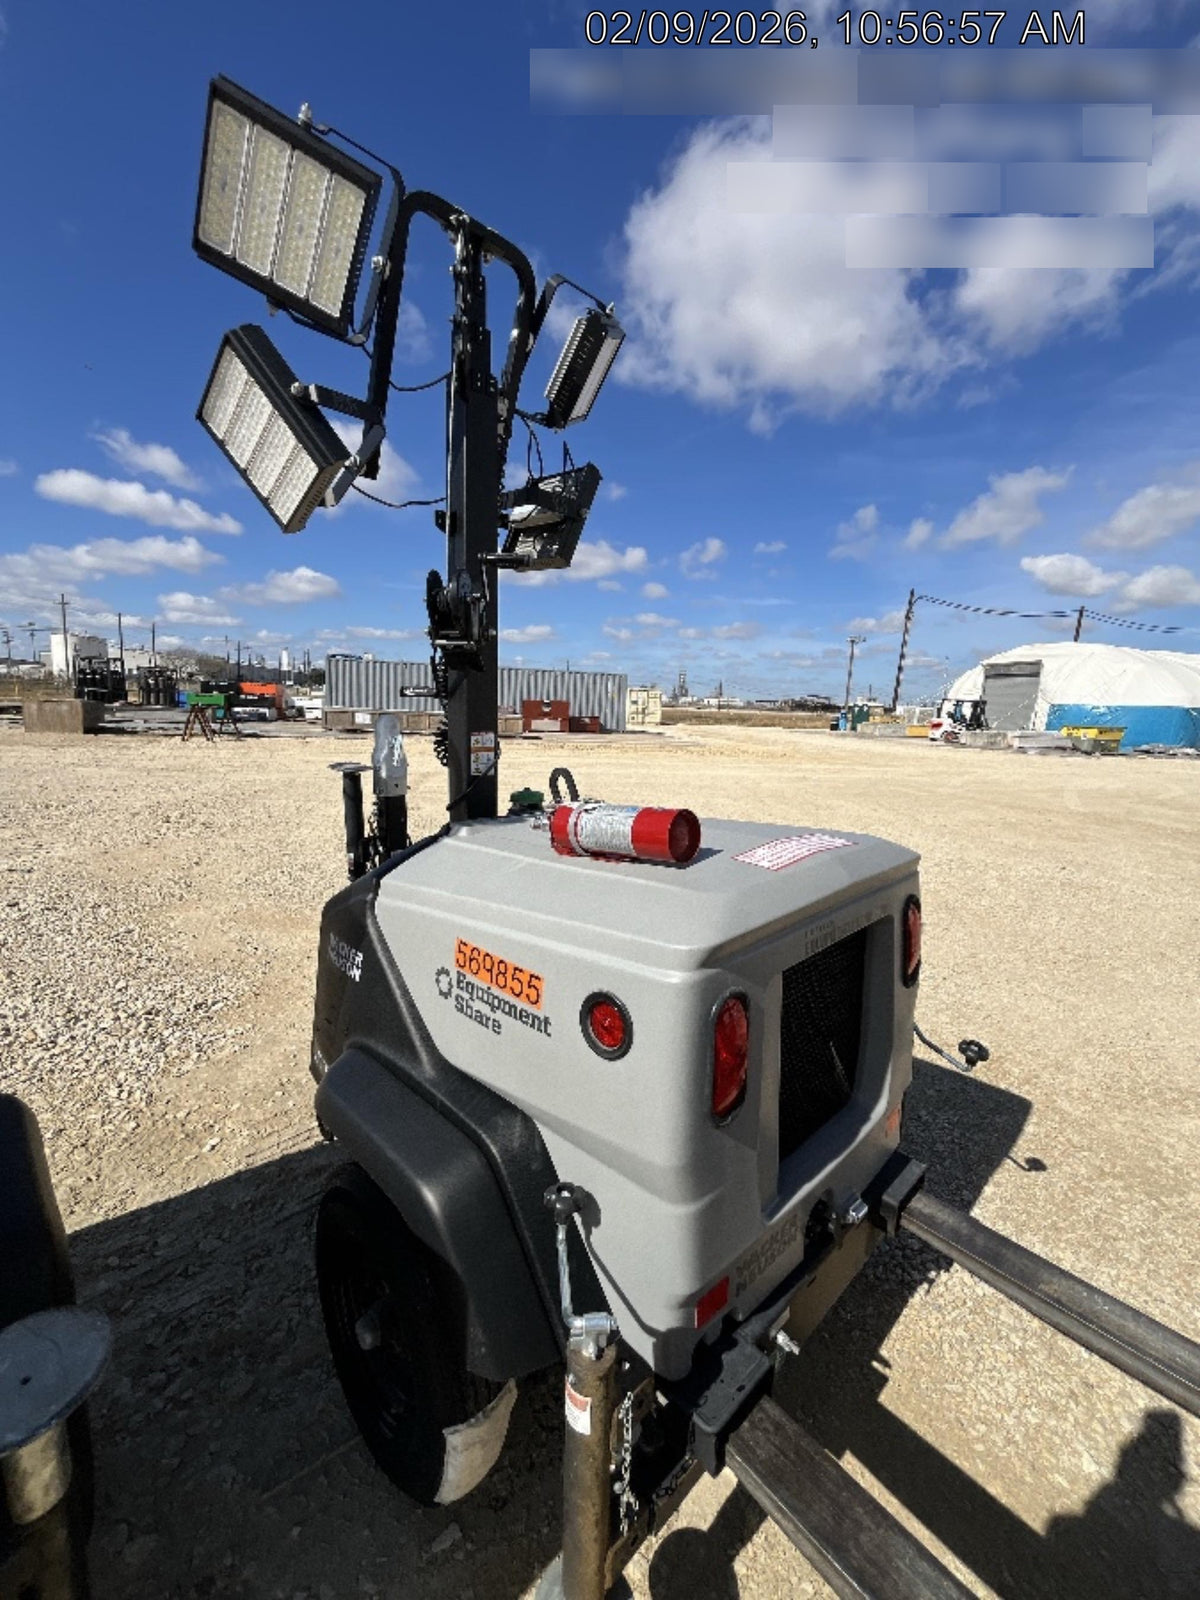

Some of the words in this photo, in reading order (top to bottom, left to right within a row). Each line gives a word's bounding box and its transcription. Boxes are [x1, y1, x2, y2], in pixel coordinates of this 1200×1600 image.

[456, 940, 542, 1005] 569855
[456, 970, 551, 1037] Equipment
[455, 993, 502, 1035] Share
